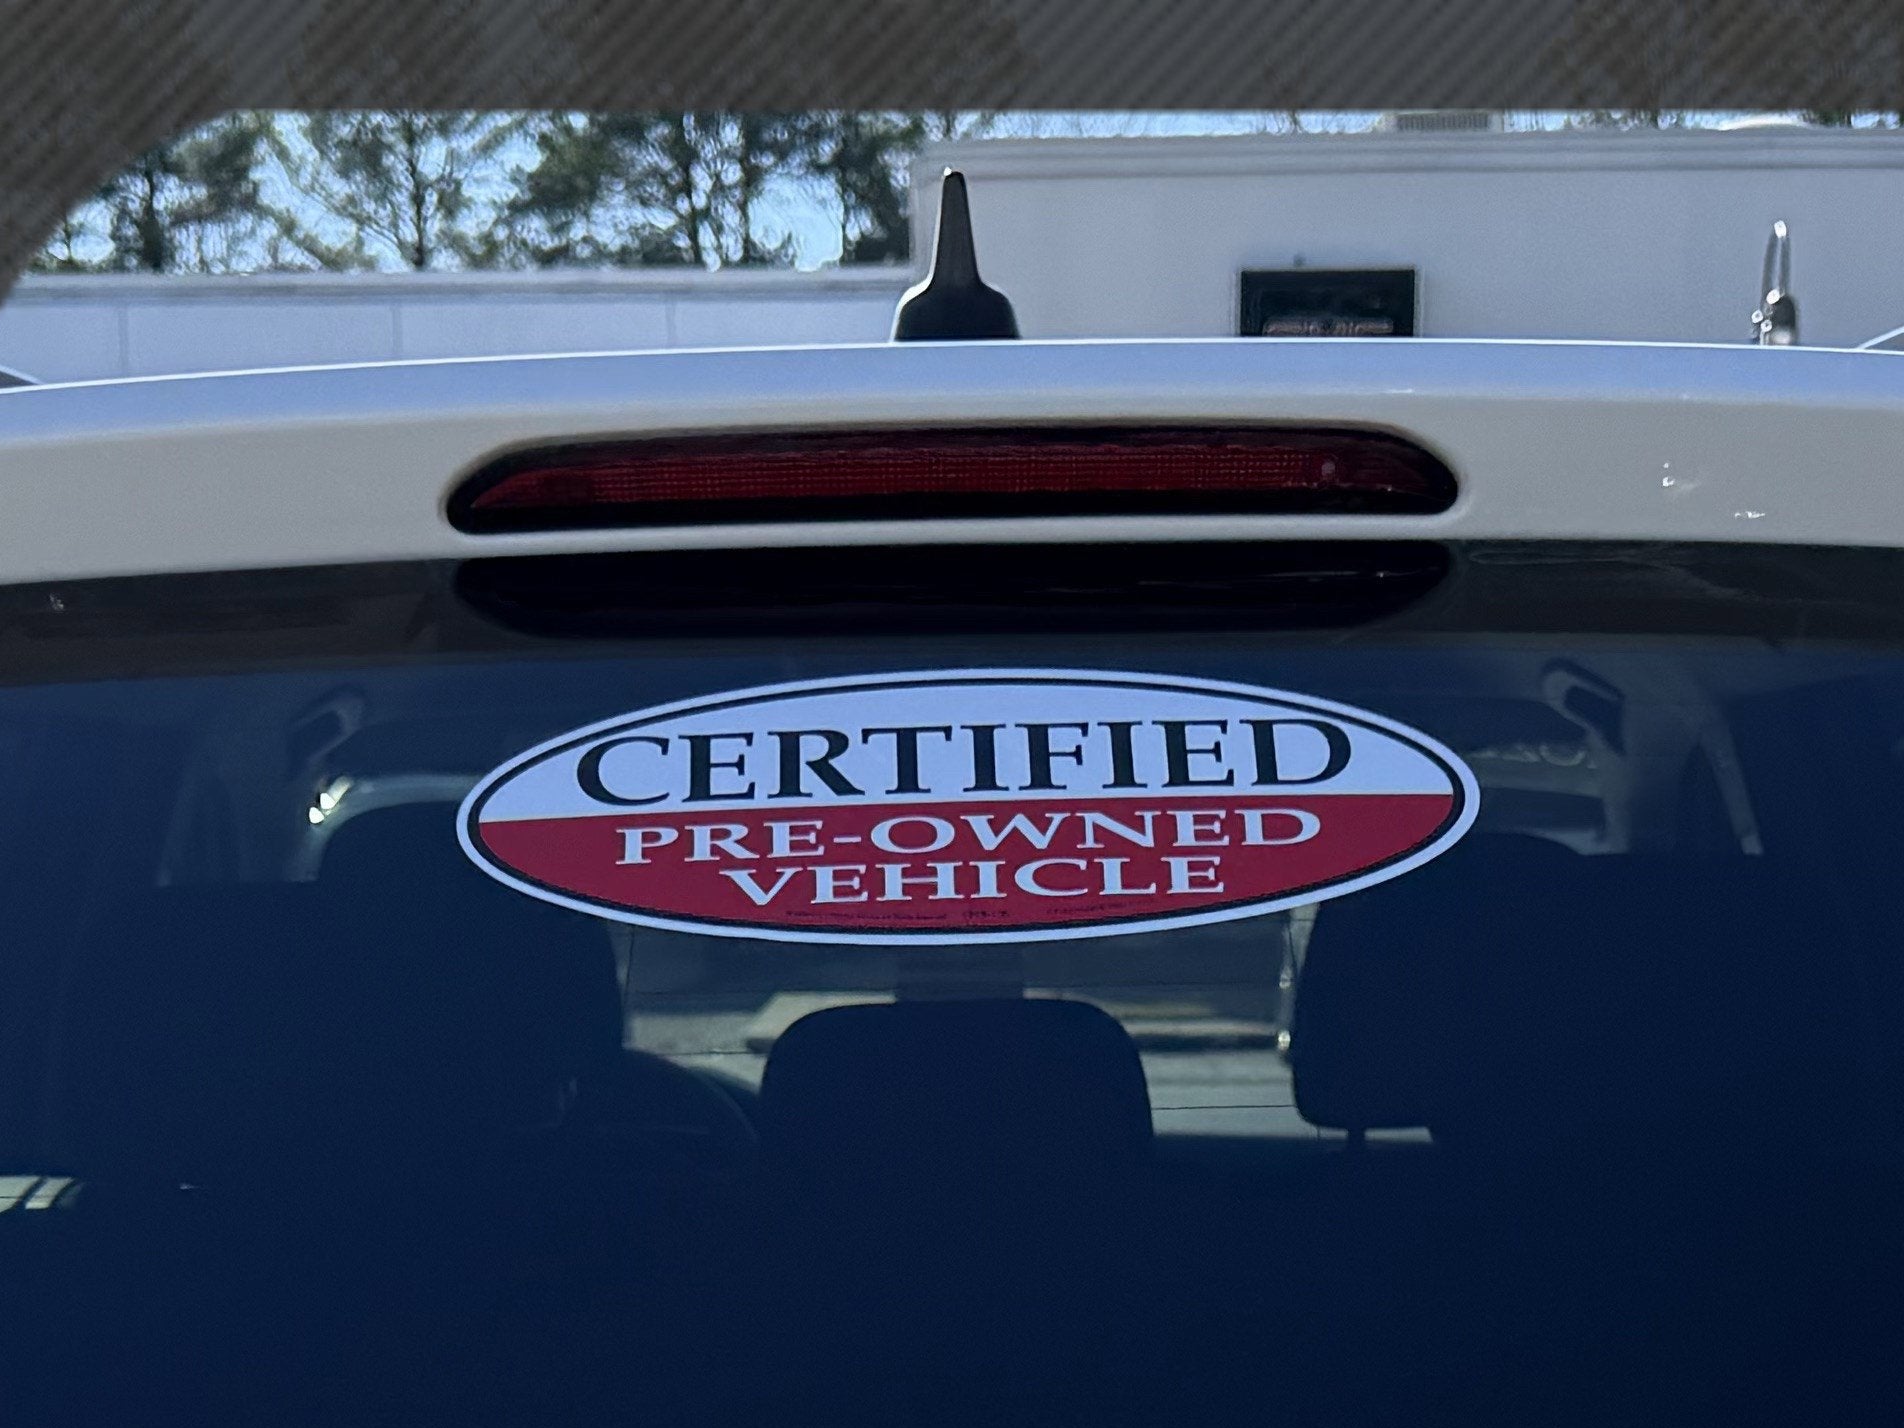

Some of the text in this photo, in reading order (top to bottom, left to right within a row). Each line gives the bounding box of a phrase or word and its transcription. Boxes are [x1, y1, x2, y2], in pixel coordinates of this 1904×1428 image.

[576, 718, 1352, 806] CERTIFIED
[615, 808, 1321, 865] PRE-OWNED
[719, 855, 1225, 906] VEHICLE
